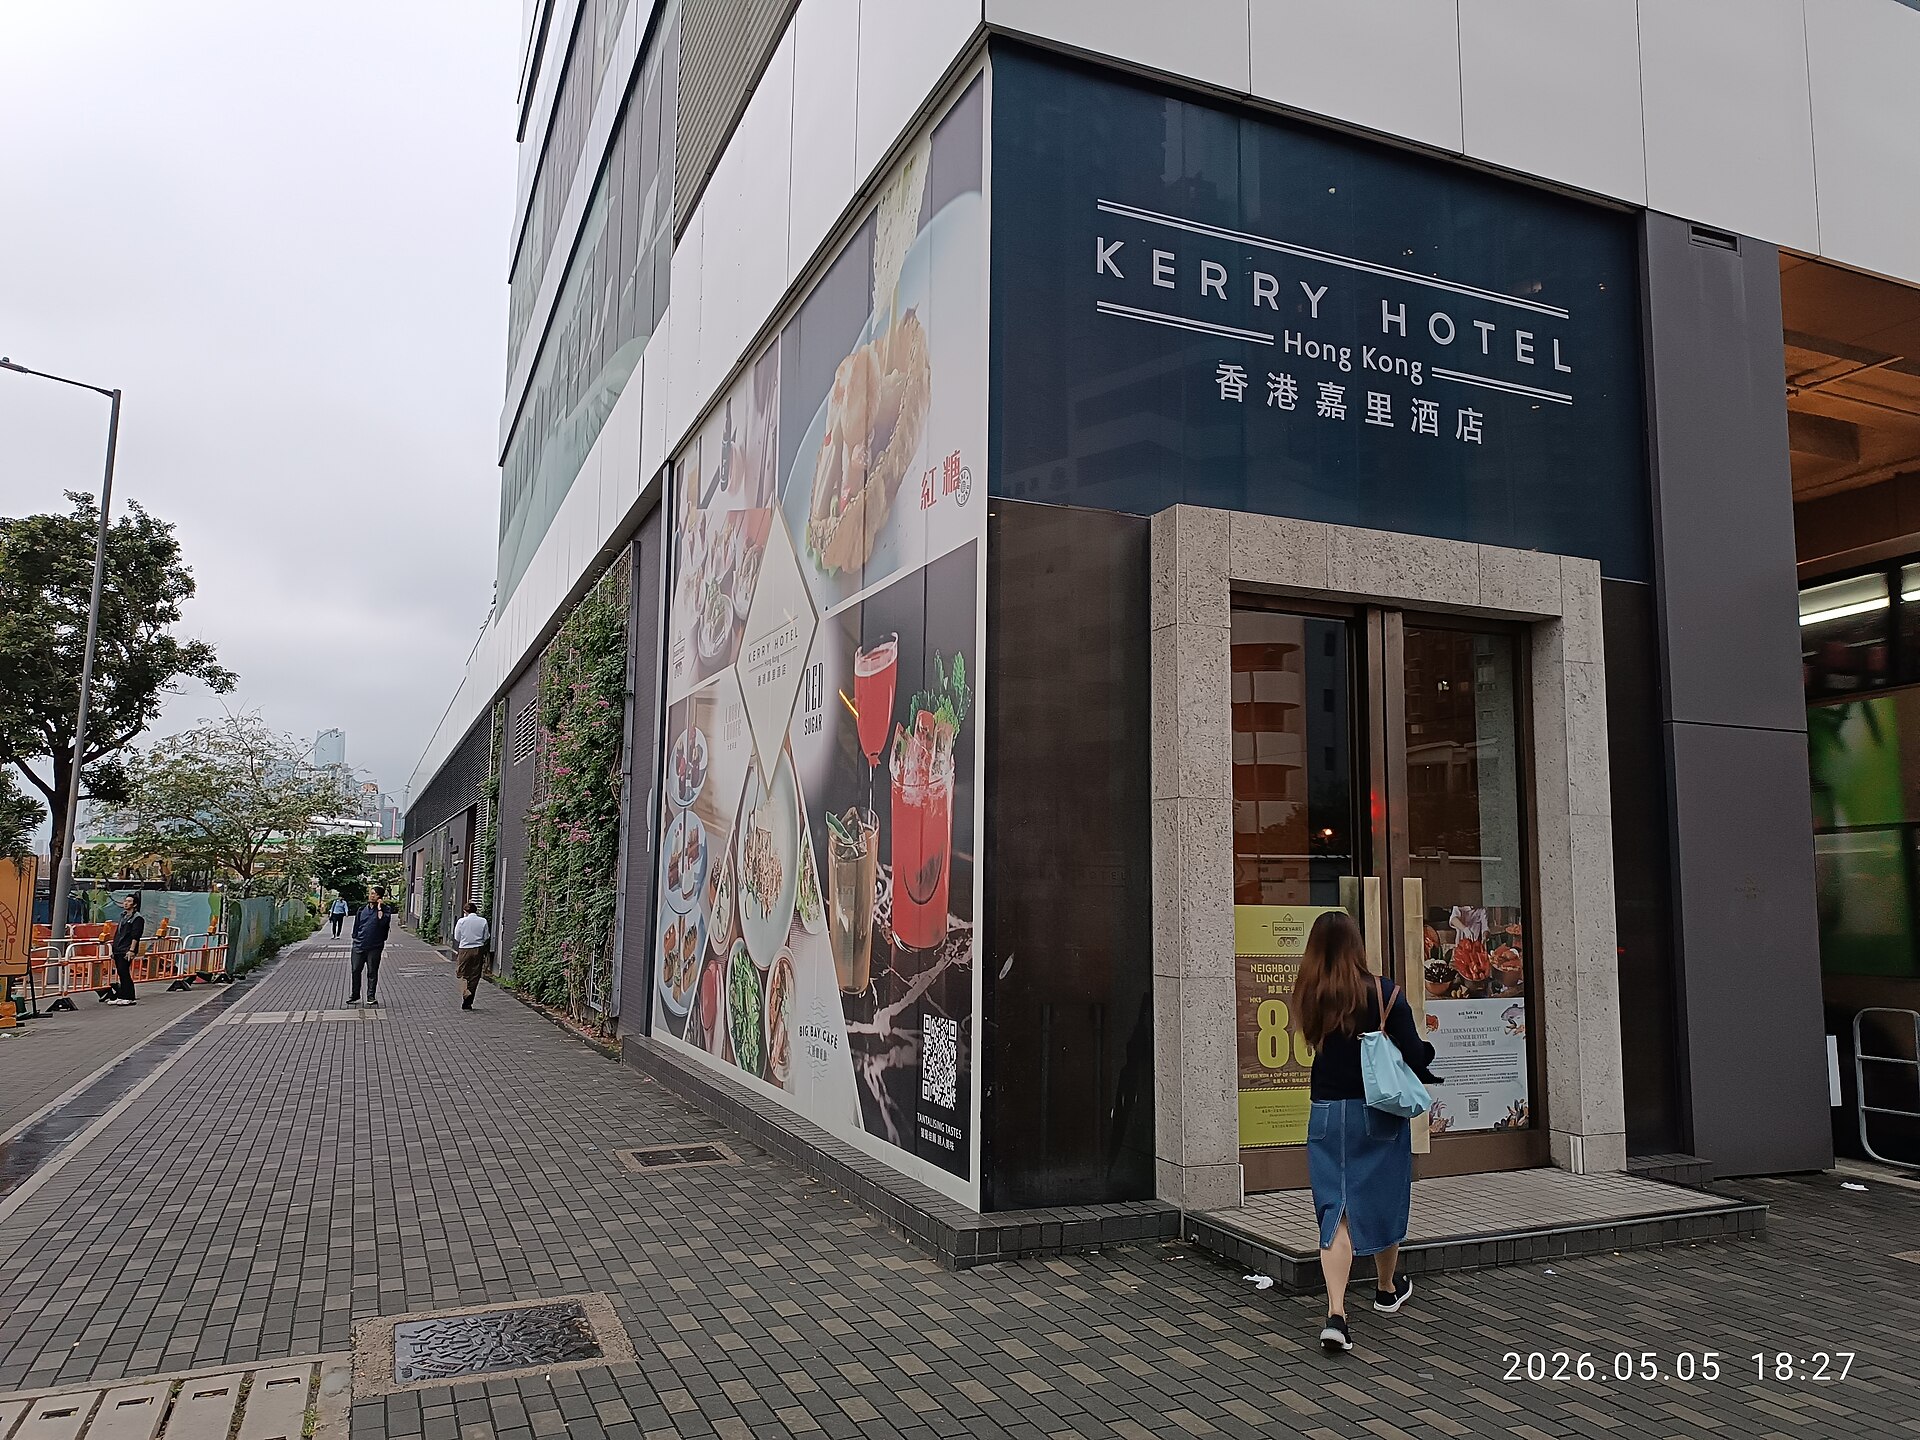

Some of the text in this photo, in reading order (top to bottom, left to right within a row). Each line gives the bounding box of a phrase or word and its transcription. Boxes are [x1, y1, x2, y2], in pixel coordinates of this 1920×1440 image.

[1096, 236, 1572, 373] KERRY HOTEL
[1283, 329, 1423, 385] Hong Kong
[1215, 363, 1484, 445] 香港嘉里酒店
[920, 449, 961, 511] 紅糖
[748, 627, 798, 662] KERRY HOTEL
[804, 662, 824, 713] RED
[803, 713, 823, 736] SUGAR
[1256, 974, 1285, 983] LUNCH
[799, 1025, 838, 1050] BIG BAY CAFÉ
[916, 1111, 962, 1140] TANTALISING TASTES
